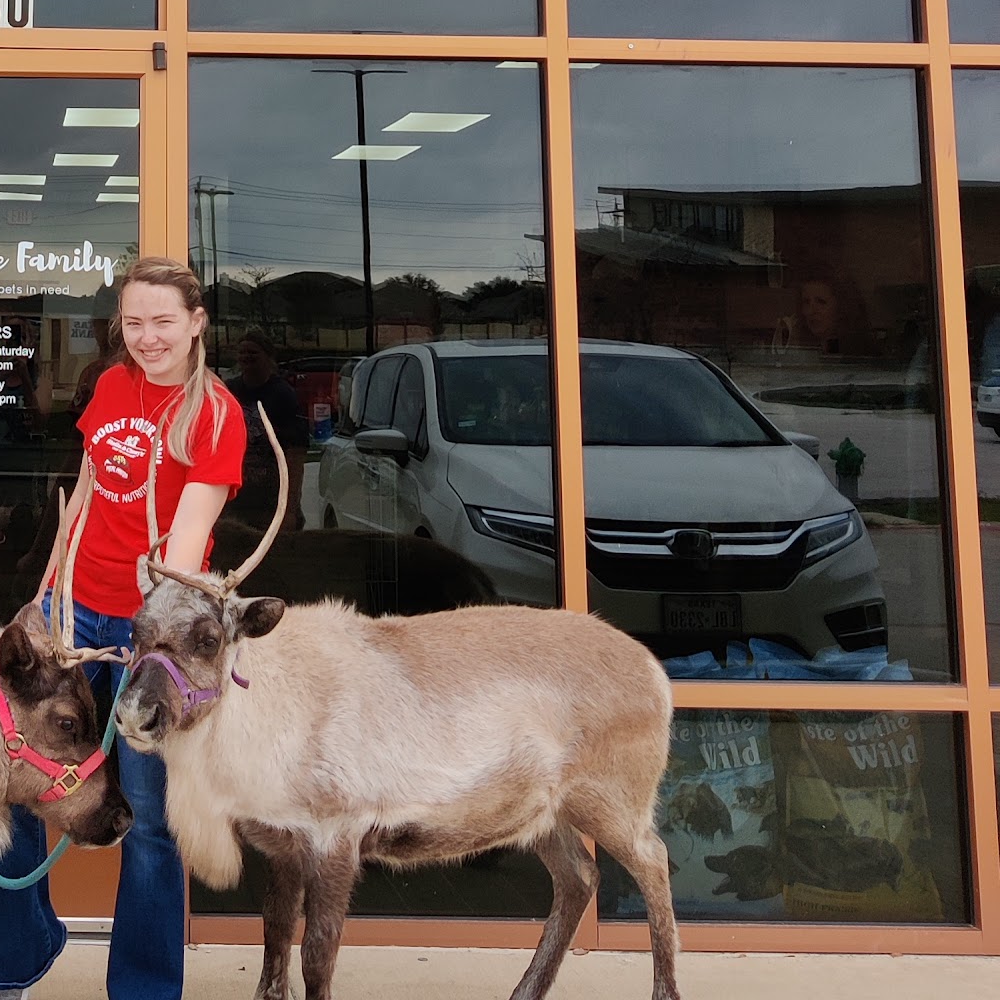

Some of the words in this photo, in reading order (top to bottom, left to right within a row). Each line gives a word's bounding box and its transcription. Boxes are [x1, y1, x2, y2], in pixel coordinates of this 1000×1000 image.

[16, 240, 120, 287] Family
[40, 285, 70, 295] need
[91, 417, 128, 445] BOOST
[846, 734, 919, 771] Wild
